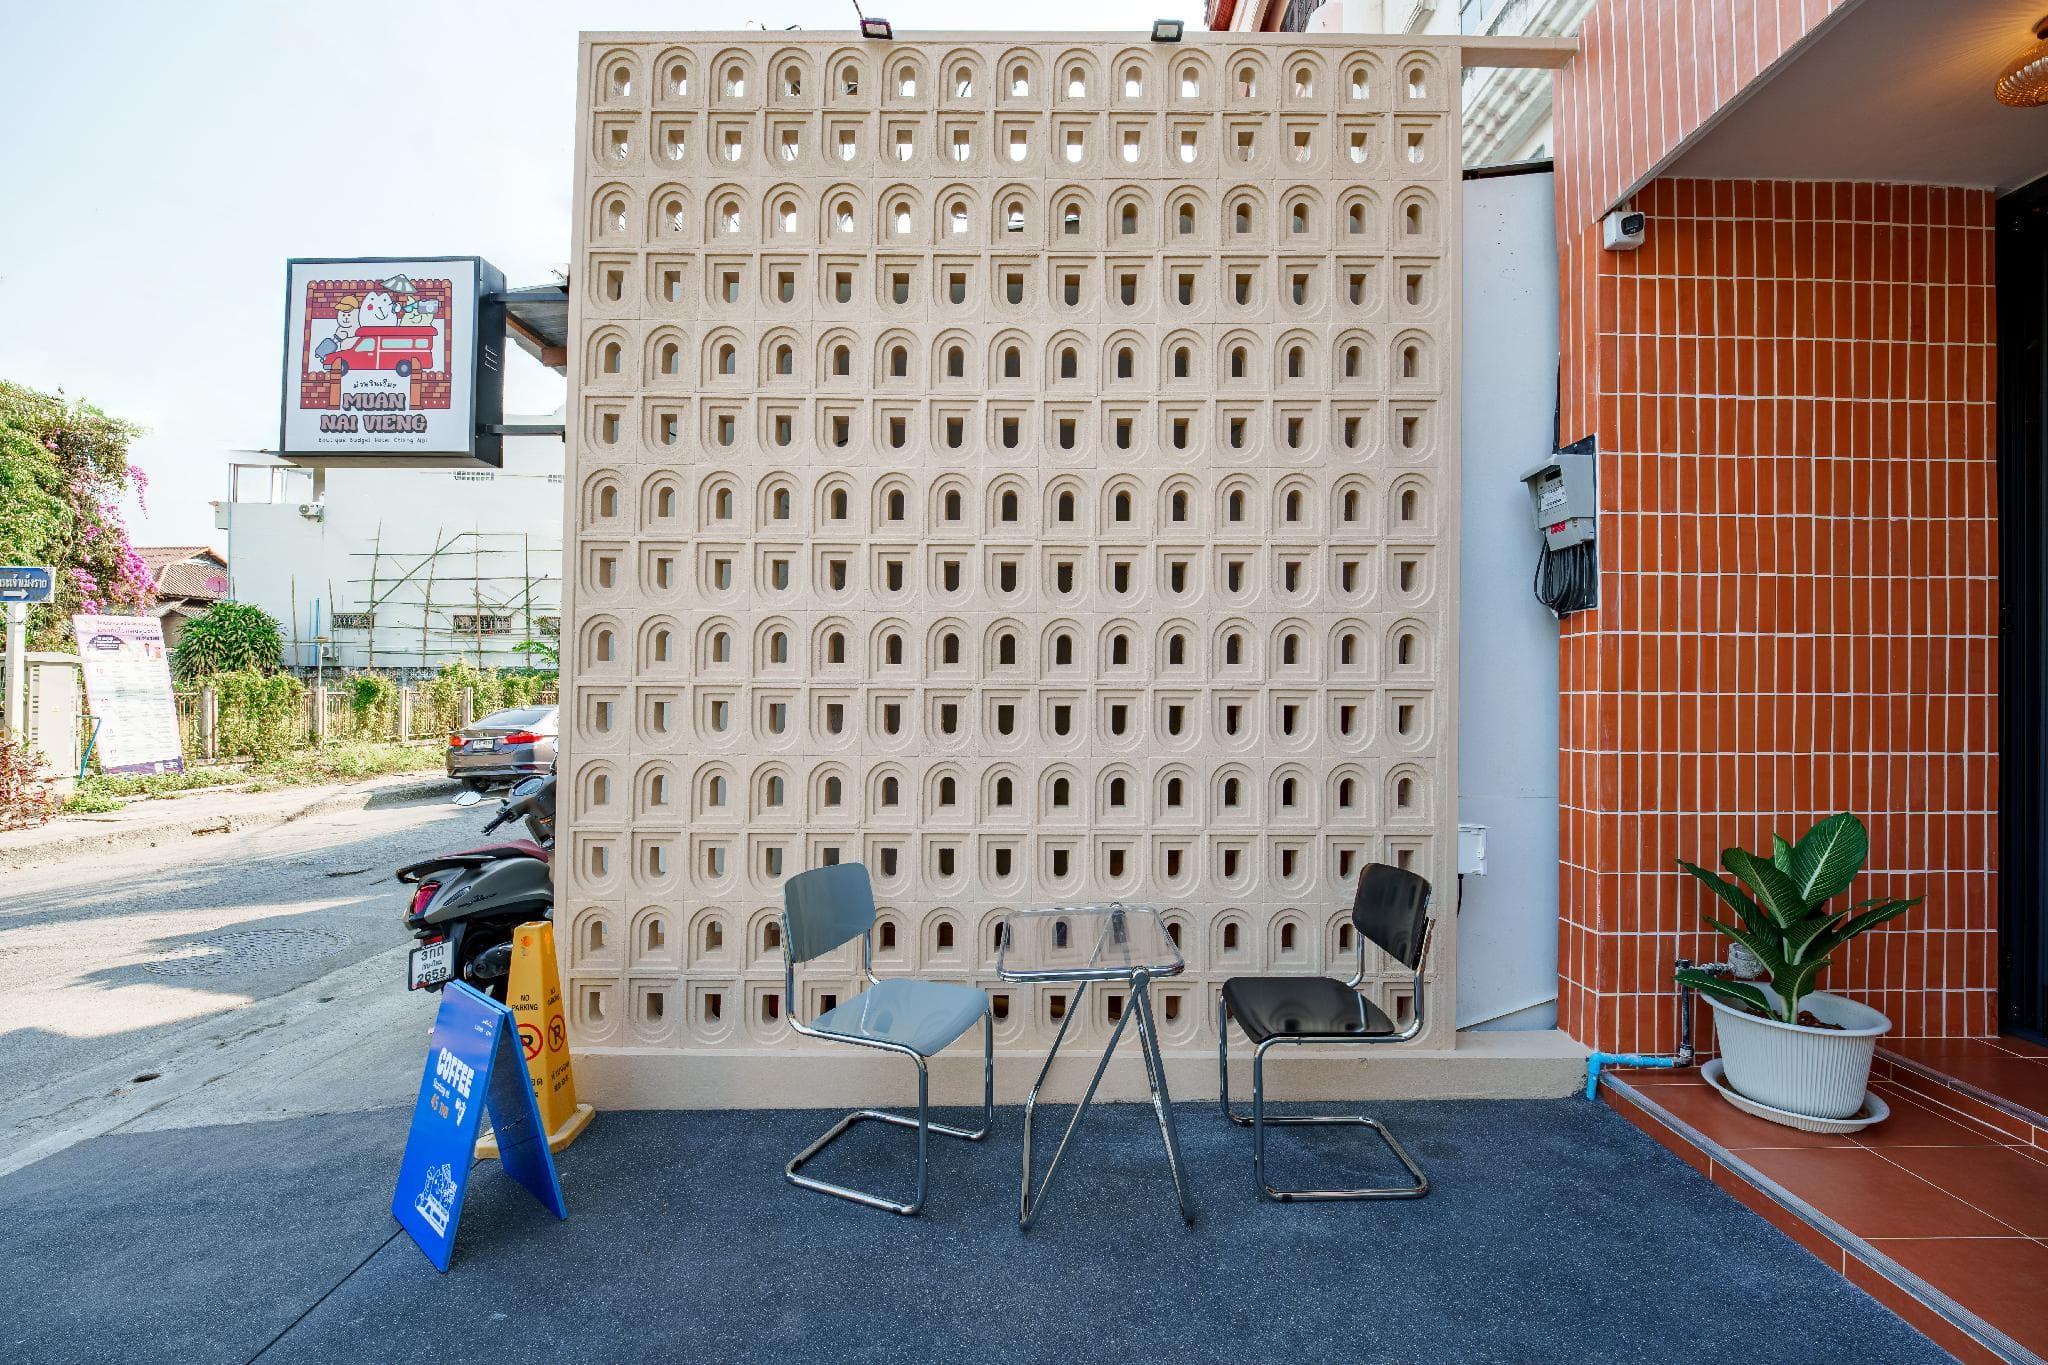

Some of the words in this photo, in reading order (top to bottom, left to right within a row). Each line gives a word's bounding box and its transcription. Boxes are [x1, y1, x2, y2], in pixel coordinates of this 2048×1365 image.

[342, 392, 406, 411] MUAN
[320, 414, 358, 433] NAI
[363, 414, 427, 433] VIENG
[417, 967, 447, 984] 2659
[512, 1003, 539, 1011] PARKING
[520, 994, 530, 1002] NO
[436, 1047, 475, 1100] COFFEE
